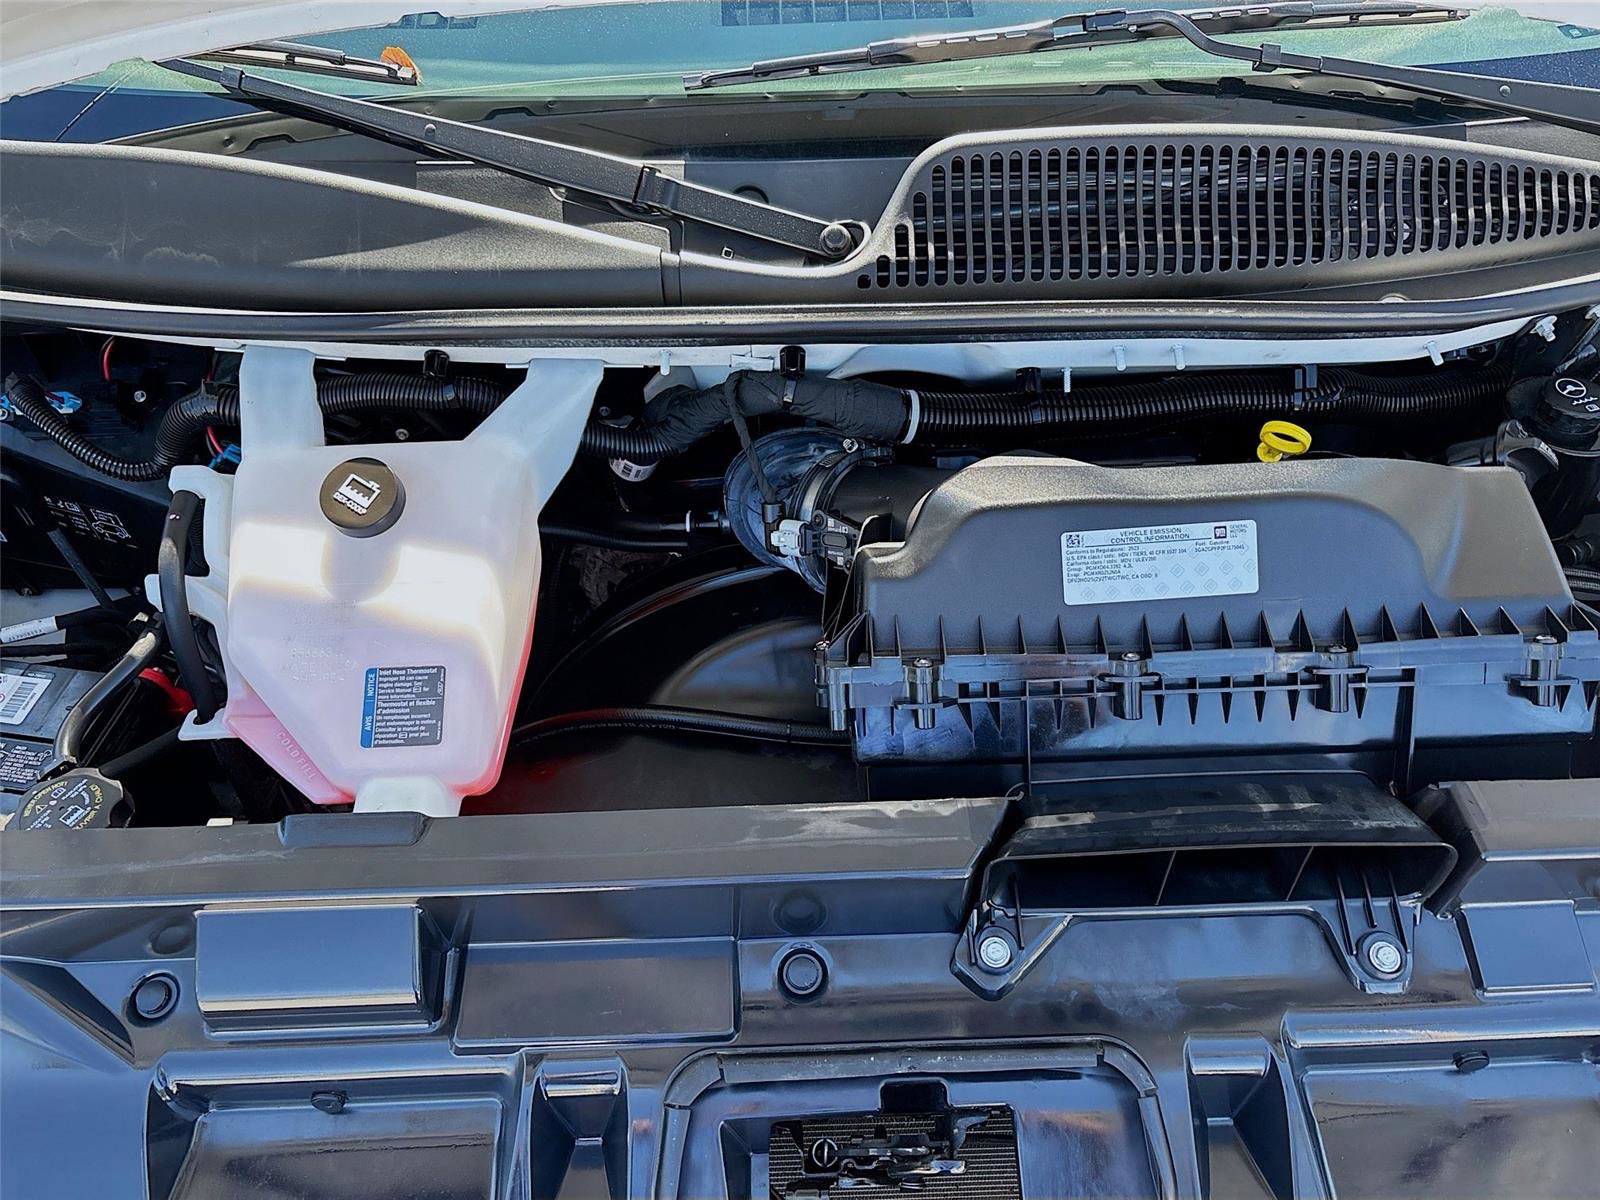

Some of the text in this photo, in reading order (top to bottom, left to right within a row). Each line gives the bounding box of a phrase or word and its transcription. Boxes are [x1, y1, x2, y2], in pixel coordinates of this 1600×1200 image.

[1144, 533, 1190, 542] INFORMATION
[367, 673, 375, 696] NOTICE
[364, 716, 372, 730] AVIS
[276, 731, 300, 758] COLD
